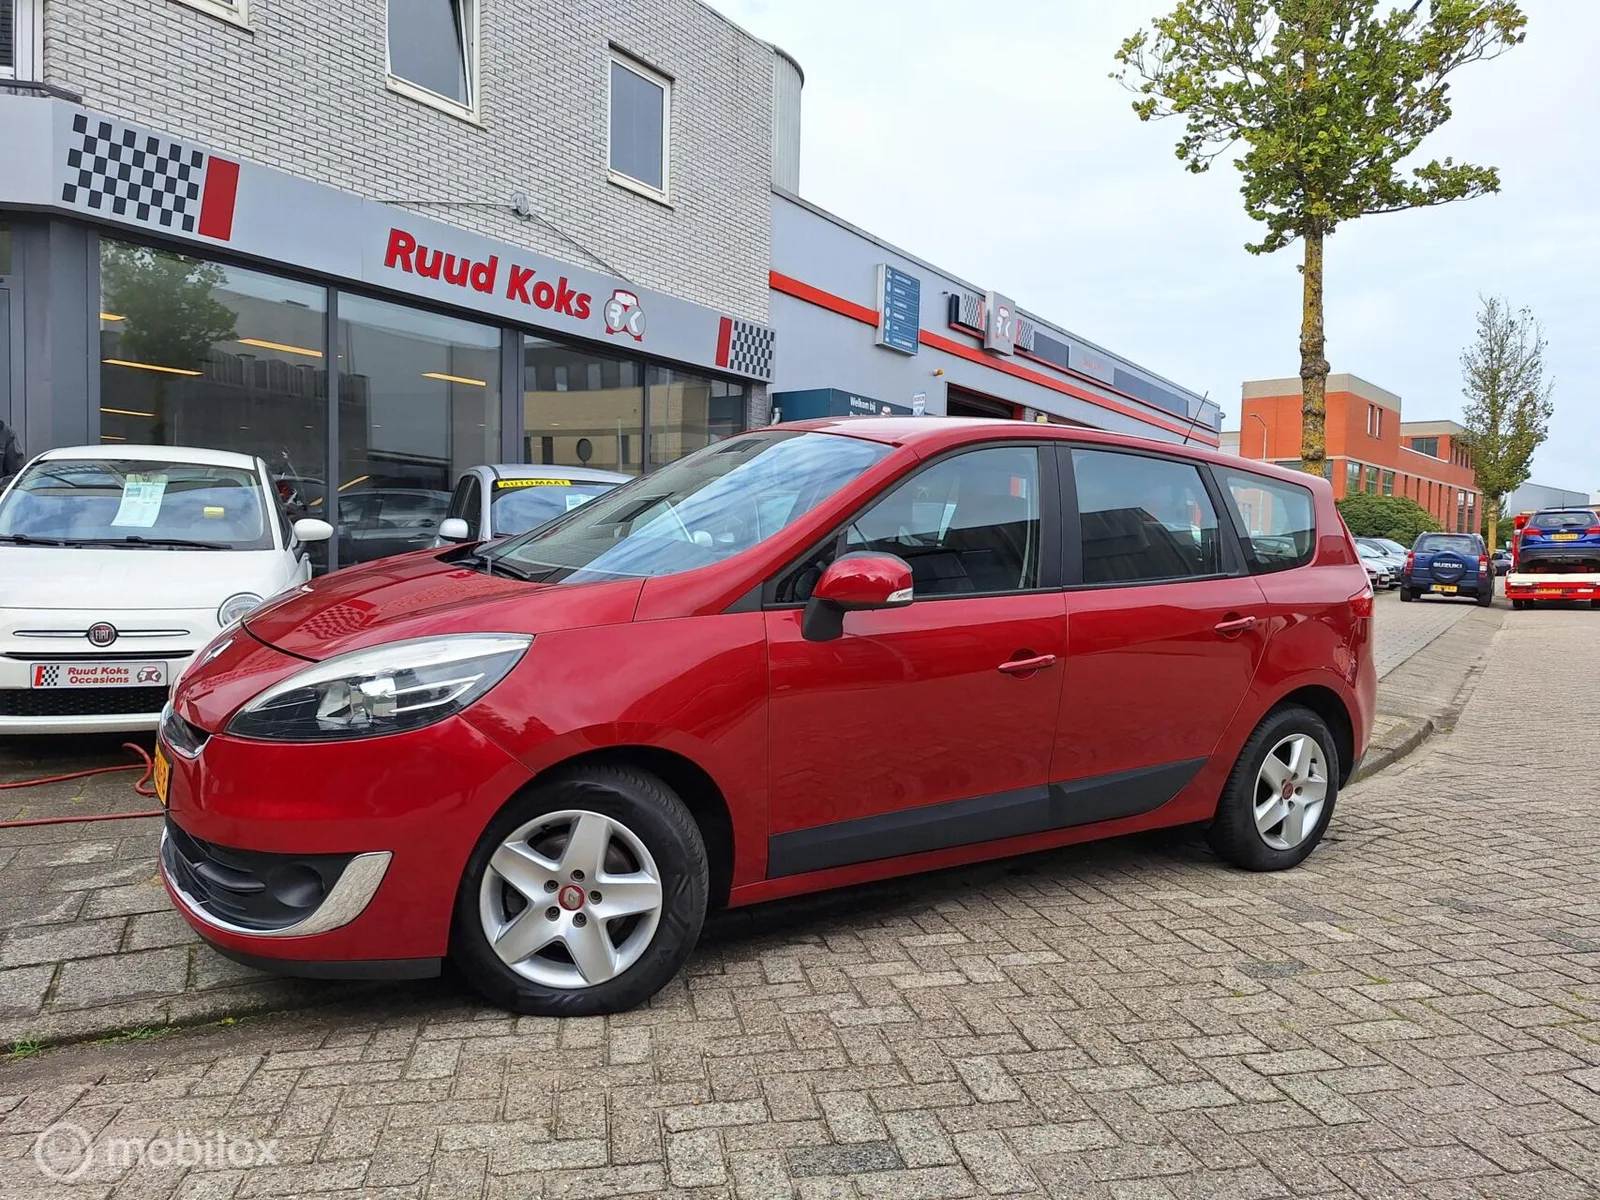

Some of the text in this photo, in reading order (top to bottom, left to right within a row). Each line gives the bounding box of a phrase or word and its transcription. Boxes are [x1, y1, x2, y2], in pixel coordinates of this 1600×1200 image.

[384, 227, 592, 320] Ruud Koks
[850, 396, 869, 410] Welkom
[95, 630, 109, 640] FIAT
[68, 667, 129, 675] Ruud Koks
[70, 675, 129, 684] Occasions
